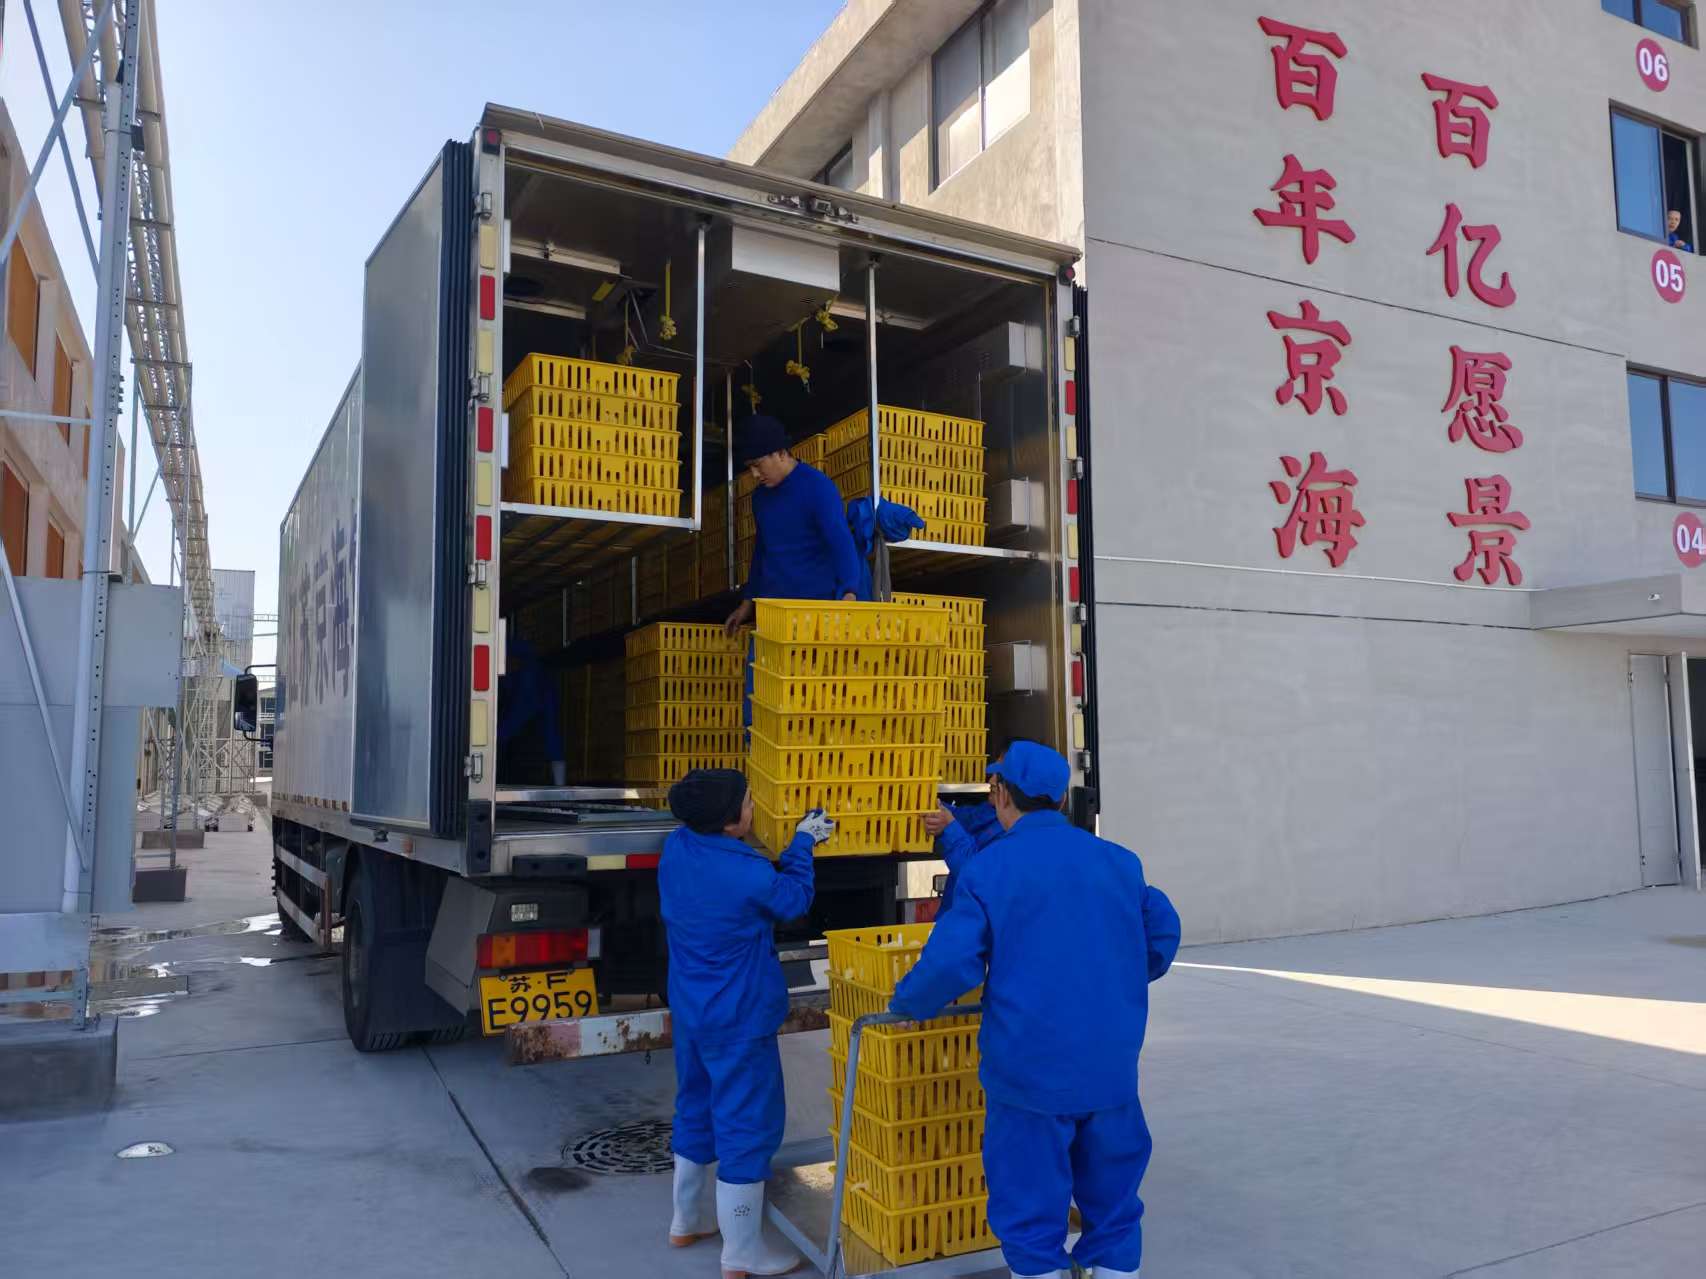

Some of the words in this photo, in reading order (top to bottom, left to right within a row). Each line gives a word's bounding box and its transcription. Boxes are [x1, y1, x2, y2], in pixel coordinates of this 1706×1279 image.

[1640, 48, 1668, 81] 06
[1253, 16, 1365, 567] 百年京海
[1655, 259, 1683, 292] 05
[1421, 72, 1530, 585] 百亿愿景
[1677, 524, 1706, 555] 04
[488, 990, 592, 1030] E9959
